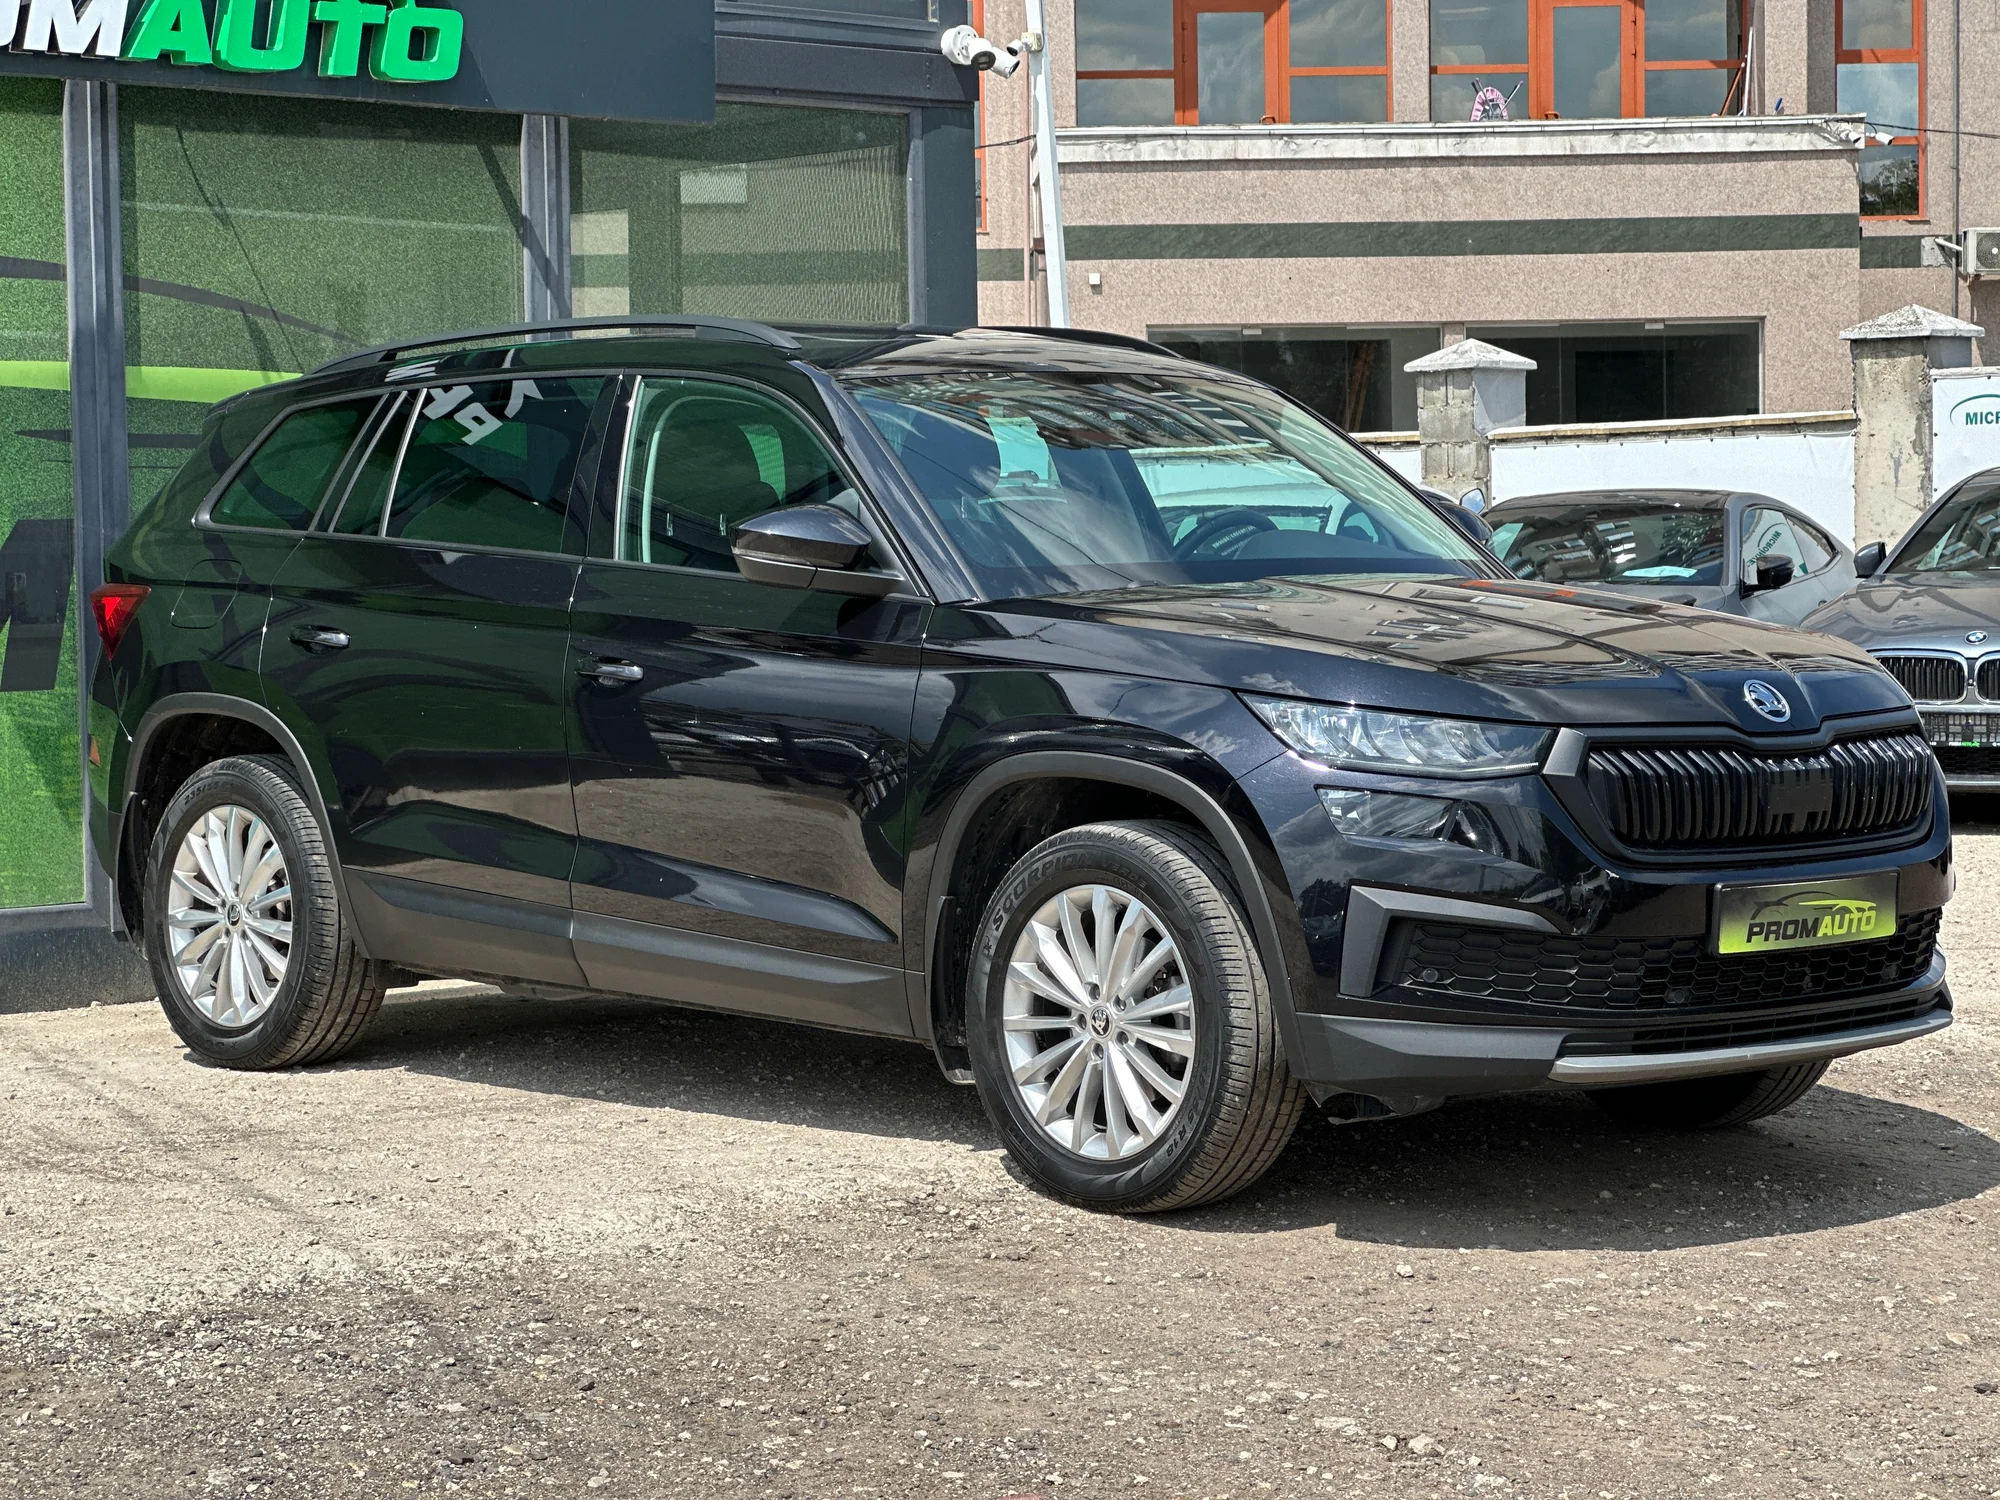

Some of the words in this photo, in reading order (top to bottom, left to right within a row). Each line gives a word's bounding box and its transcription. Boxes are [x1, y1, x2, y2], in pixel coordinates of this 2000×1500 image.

[0, 0, 464, 82] MAUTO
[992, 852, 1097, 932] SCORPION
[1745, 910, 1877, 943] PROMAUTO
